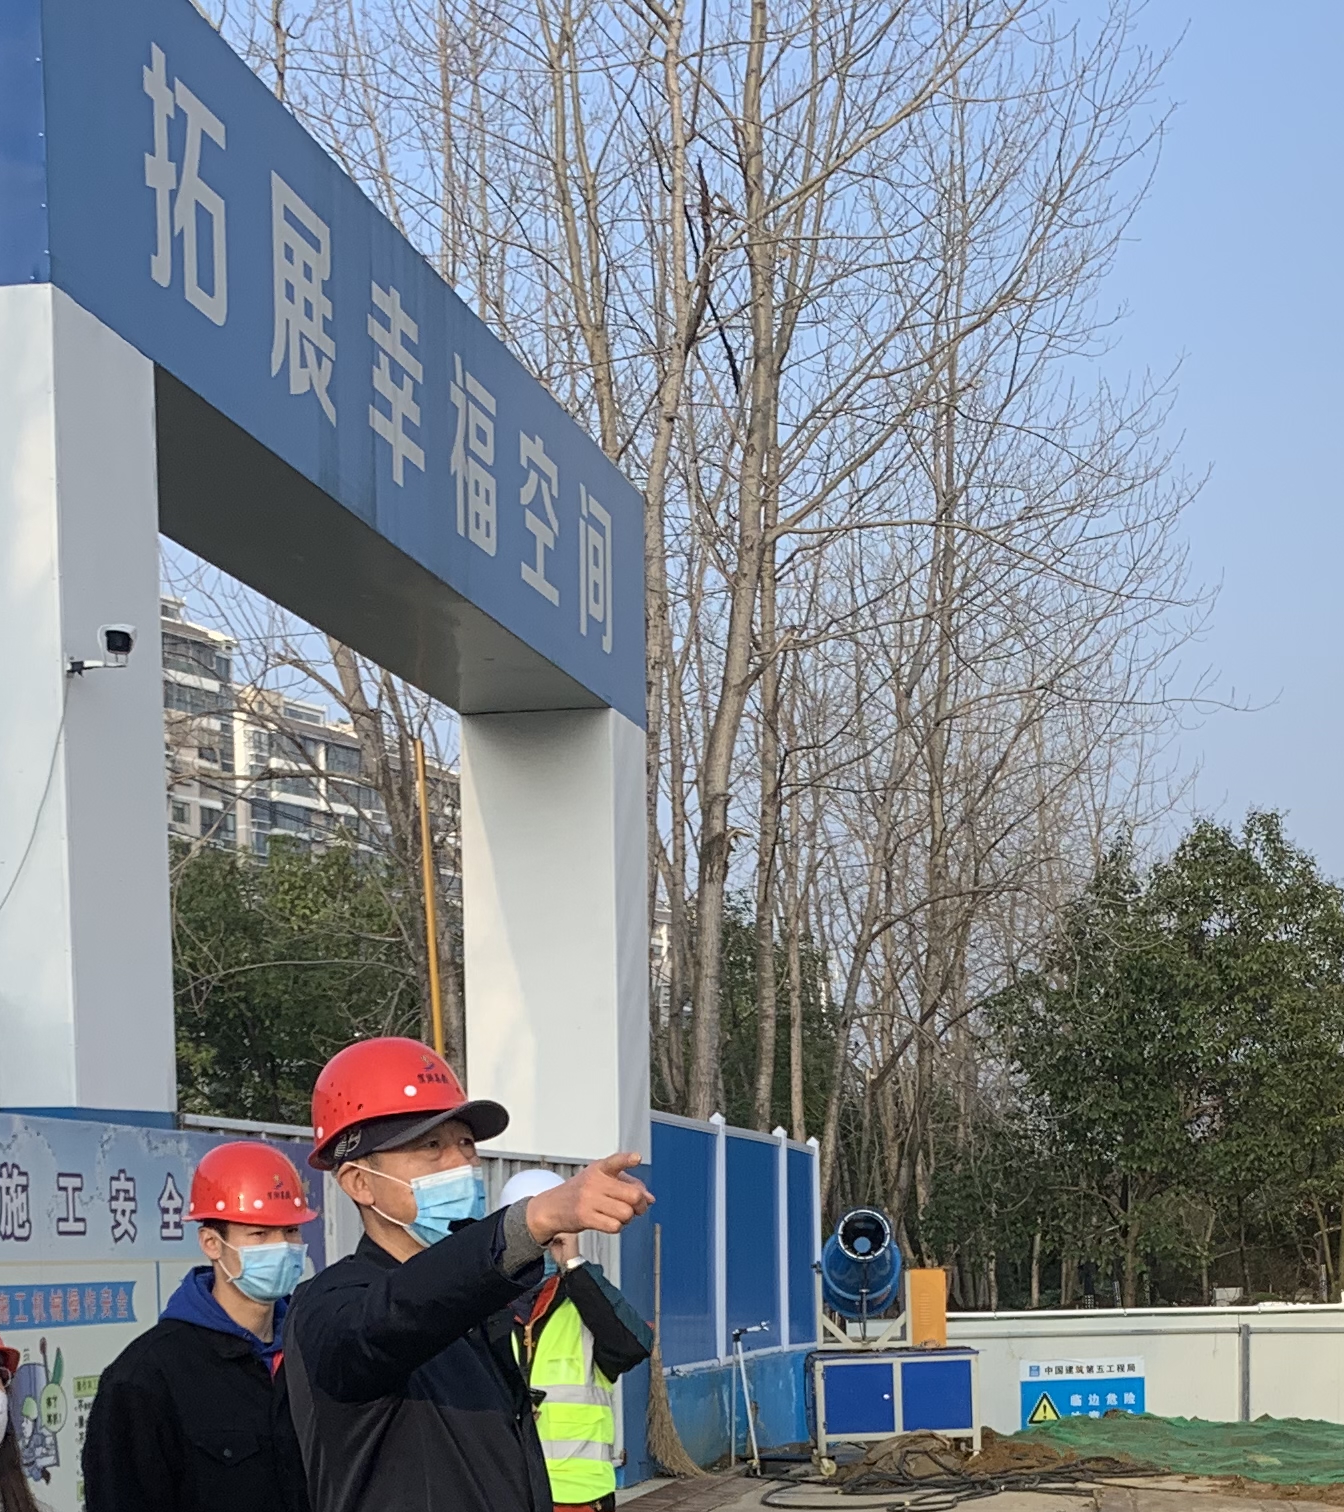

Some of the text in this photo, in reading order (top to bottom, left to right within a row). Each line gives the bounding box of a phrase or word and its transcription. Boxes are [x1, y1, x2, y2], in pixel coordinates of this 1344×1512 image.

[143, 42, 612, 655] 拓展幸福空间
[1044, 1362, 1137, 1376] 中国建筑第五工程局
[1069, 1391, 1136, 1407] 临边危险
